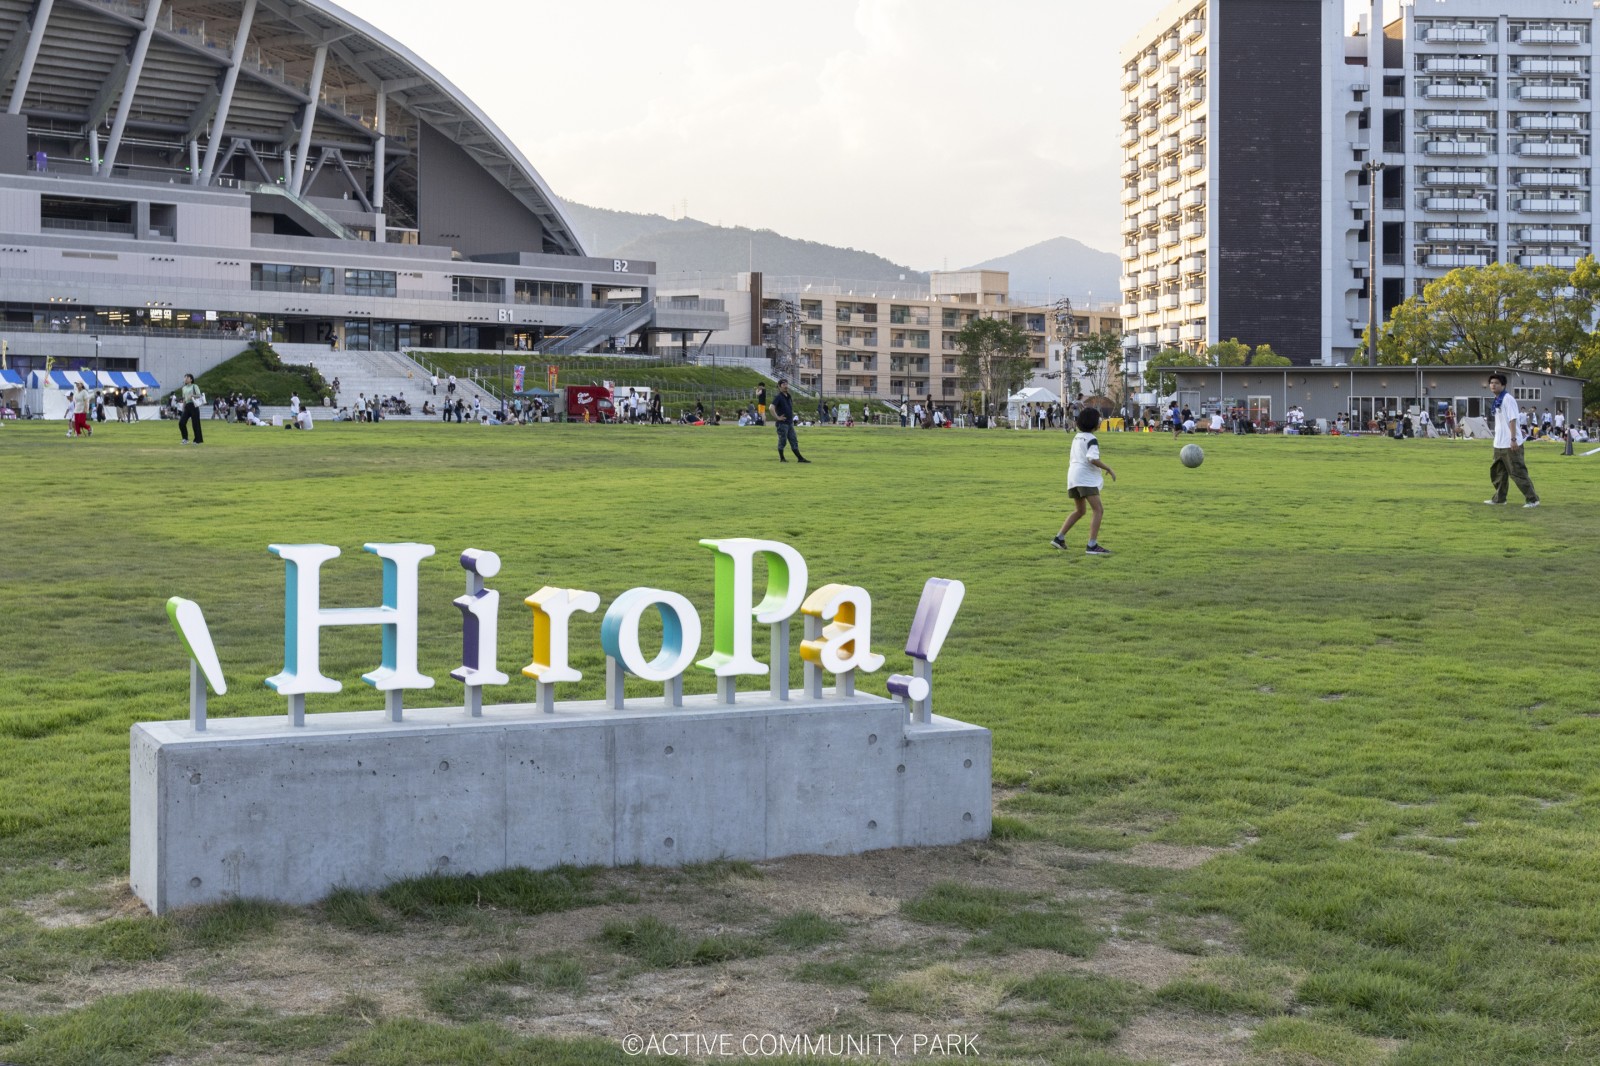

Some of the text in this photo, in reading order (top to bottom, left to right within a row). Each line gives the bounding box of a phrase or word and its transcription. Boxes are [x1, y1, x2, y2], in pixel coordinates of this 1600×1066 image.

[613, 259, 629, 272] B2
[498, 308, 513, 322] B1
[317, 322, 333, 341] F2
